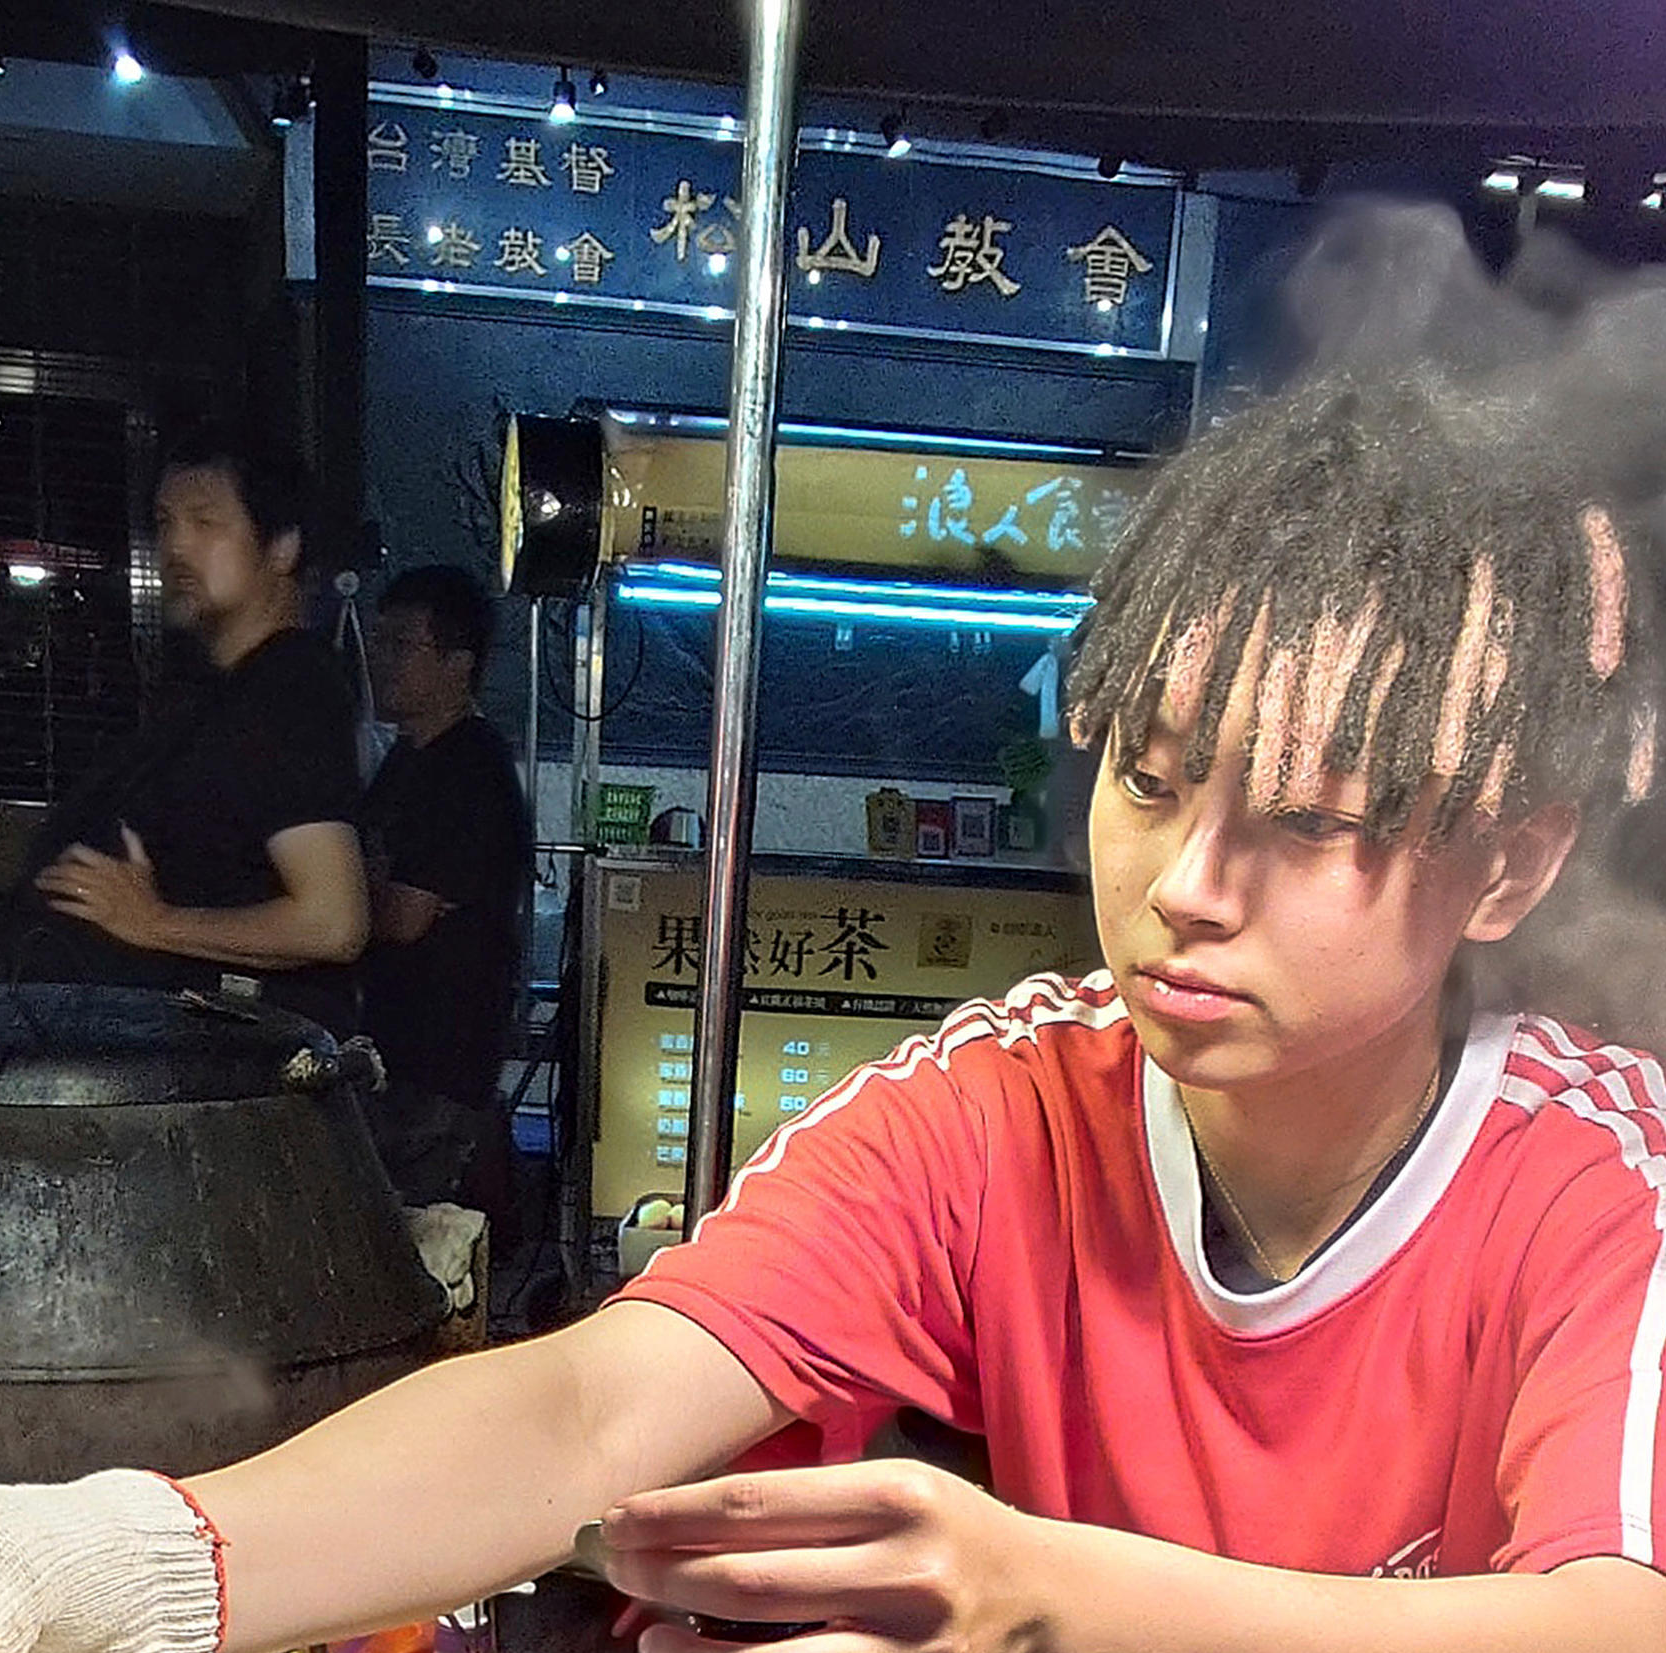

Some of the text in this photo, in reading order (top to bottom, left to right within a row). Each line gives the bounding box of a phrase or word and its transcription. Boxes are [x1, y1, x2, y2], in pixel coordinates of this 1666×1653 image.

[367, 121, 615, 194] 台灣基督
[367, 212, 614, 284] 長老教會
[783, 1041, 809, 1055] 40
